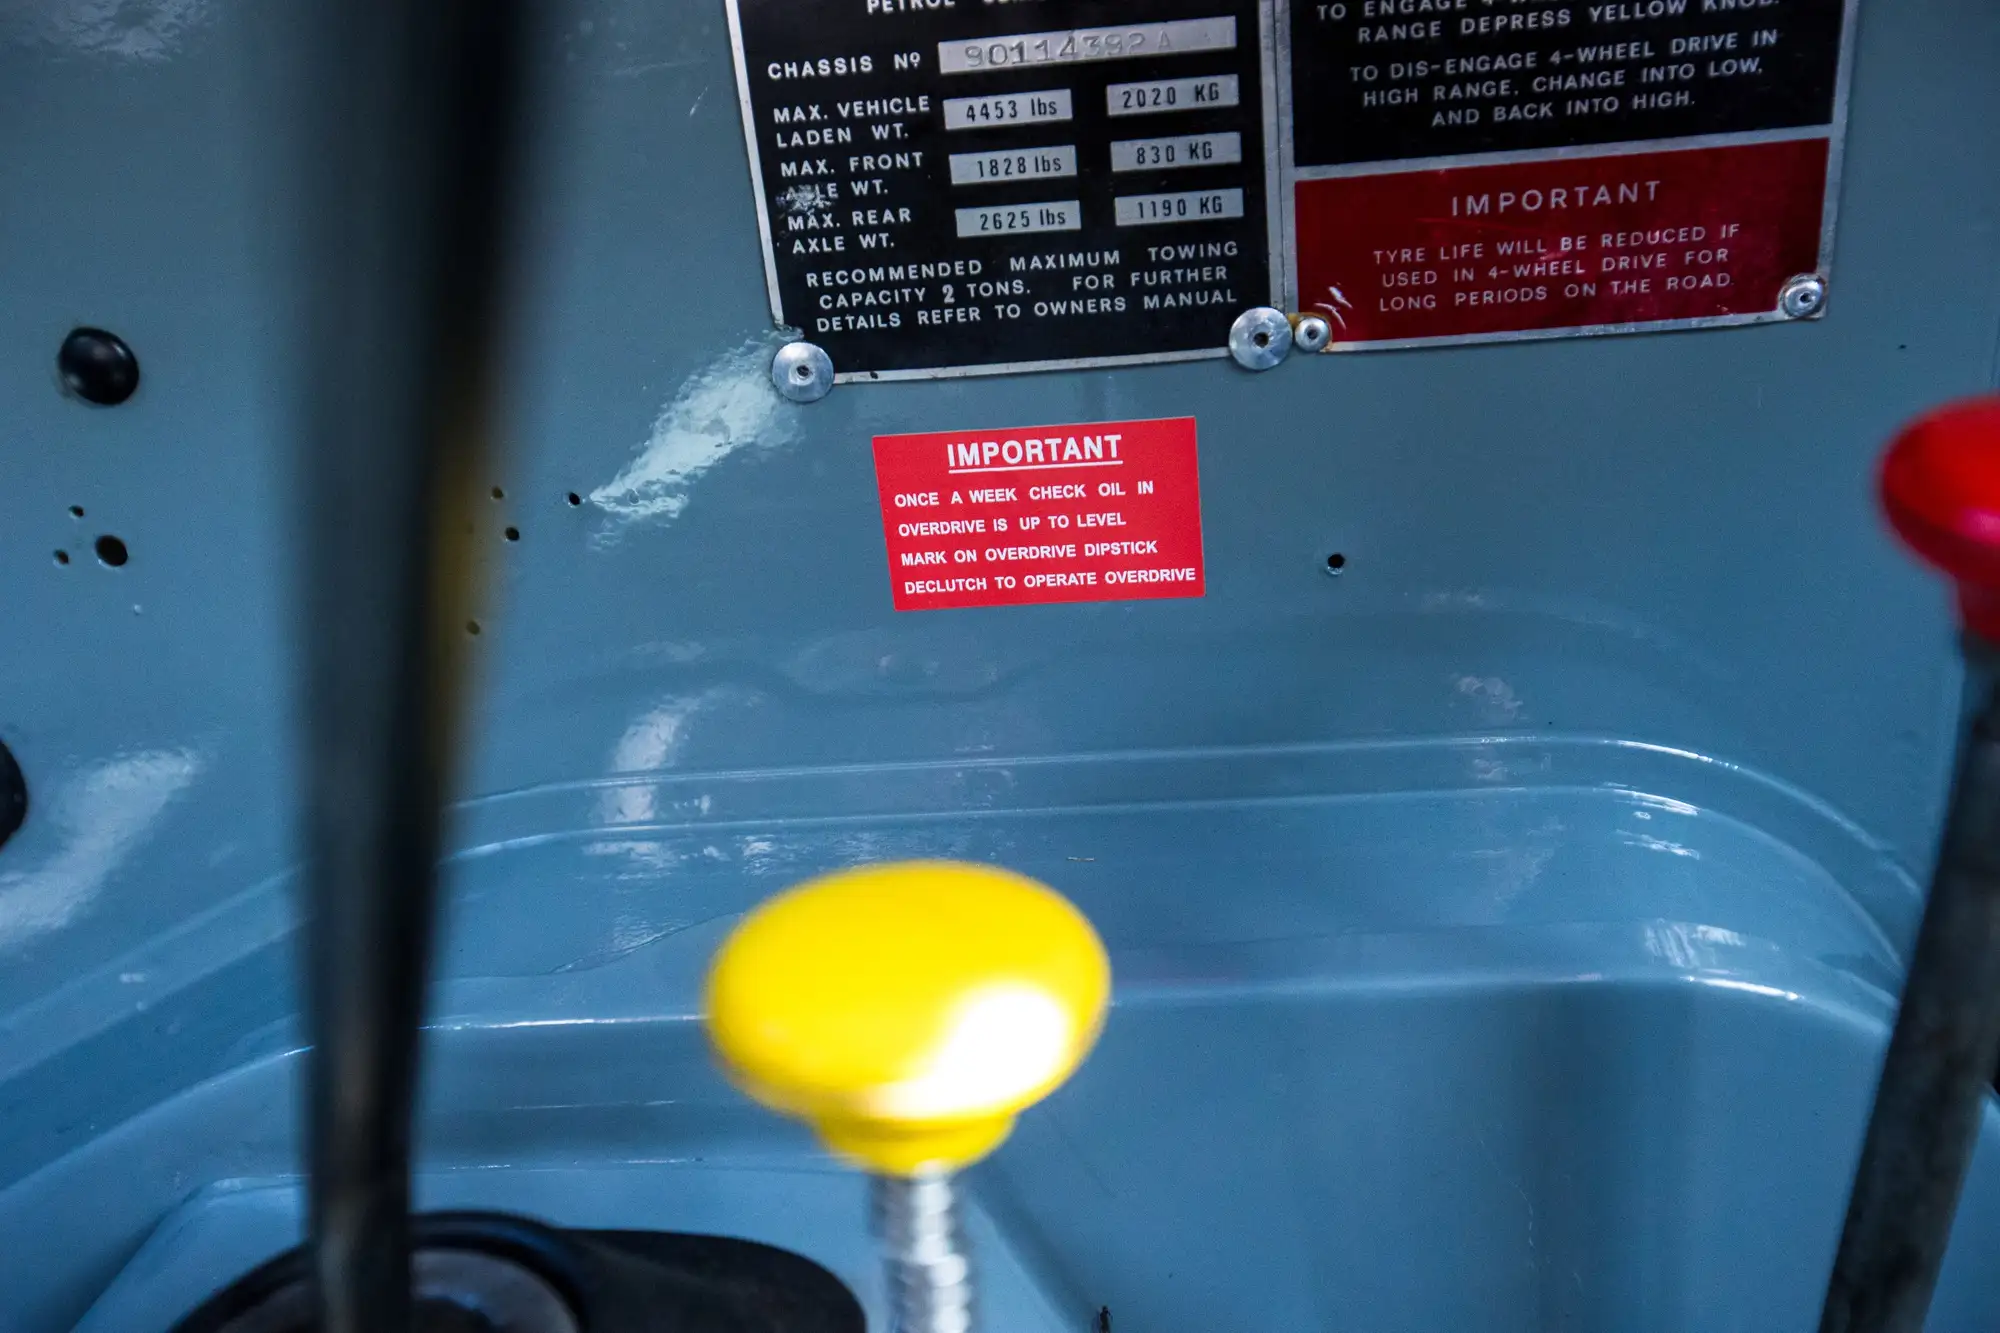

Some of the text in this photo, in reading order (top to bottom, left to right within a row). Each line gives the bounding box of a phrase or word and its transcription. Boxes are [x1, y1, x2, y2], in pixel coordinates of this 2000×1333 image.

[1317, 0, 1466, 19] TO ENGAGE
[1359, 21, 1440, 42] RANGE
[1461, 9, 1570, 34] DEPRESS
[1590, 0, 1688, 22] YELLOW
[768, 56, 872, 79] CHASSIS
[1351, 30, 1777, 81] TO DIS-ENGAGE 4-WHEEL DRIVE IN
[1123, 83, 1218, 108] 2020 KG
[1364, 88, 1417, 106] HIGH
[1533, 70, 1625, 91] CHANGE
[1643, 64, 1695, 82] INTO
[774, 96, 929, 123] MAX. VEHICLE
[967, 98, 1057, 121] 4453 lbs
[1432, 91, 1694, 126] AND BACK INTO HIGH.
[777, 123, 908, 147] LADEN WT.
[781, 152, 922, 176] MAX. FRONT
[1137, 142, 1212, 164] 830 KG
[978, 156, 1061, 177] 1828 lbs
[851, 179, 887, 195] WT.
[1452, 181, 1659, 216] IMPORTANT
[788, 208, 910, 230] MAX. REAR
[980, 209, 1065, 230] 2625 lbs
[1139, 196, 1221, 218] 1190 KG
[793, 233, 894, 254] AXLE WT.
[1374, 224, 1739, 264] TYRE LIFE WILL BE REDUCED IF
[807, 241, 1237, 287] RECOMMENDED MAXIMUM TOWING
[1383, 248, 1728, 287] USED IN 4-WHEEL DRIVE FOR
[820, 266, 1226, 309] CAPACITY 2 TONS. FOR FURTHER
[1380, 295, 1435, 311] LONG
[1456, 286, 1546, 305] PERIODS
[1565, 283, 1595, 297] ON
[1611, 279, 1650, 294] THE
[817, 289, 1236, 332] DETAILS REFER TO OWNERS MANUAL
[947, 435, 1122, 467] IMPORTANT
[895, 481, 1153, 507] ONCE A WEEK CHECK OIL IN
[899, 513, 1126, 536] OVERDRIVE IS UP TO LEVEL
[901, 541, 1157, 565] MARK ON OVERDRIVE DIPSTICK
[905, 568, 1195, 594] DECLUTCH TO OPERATE OVERDRIVE
